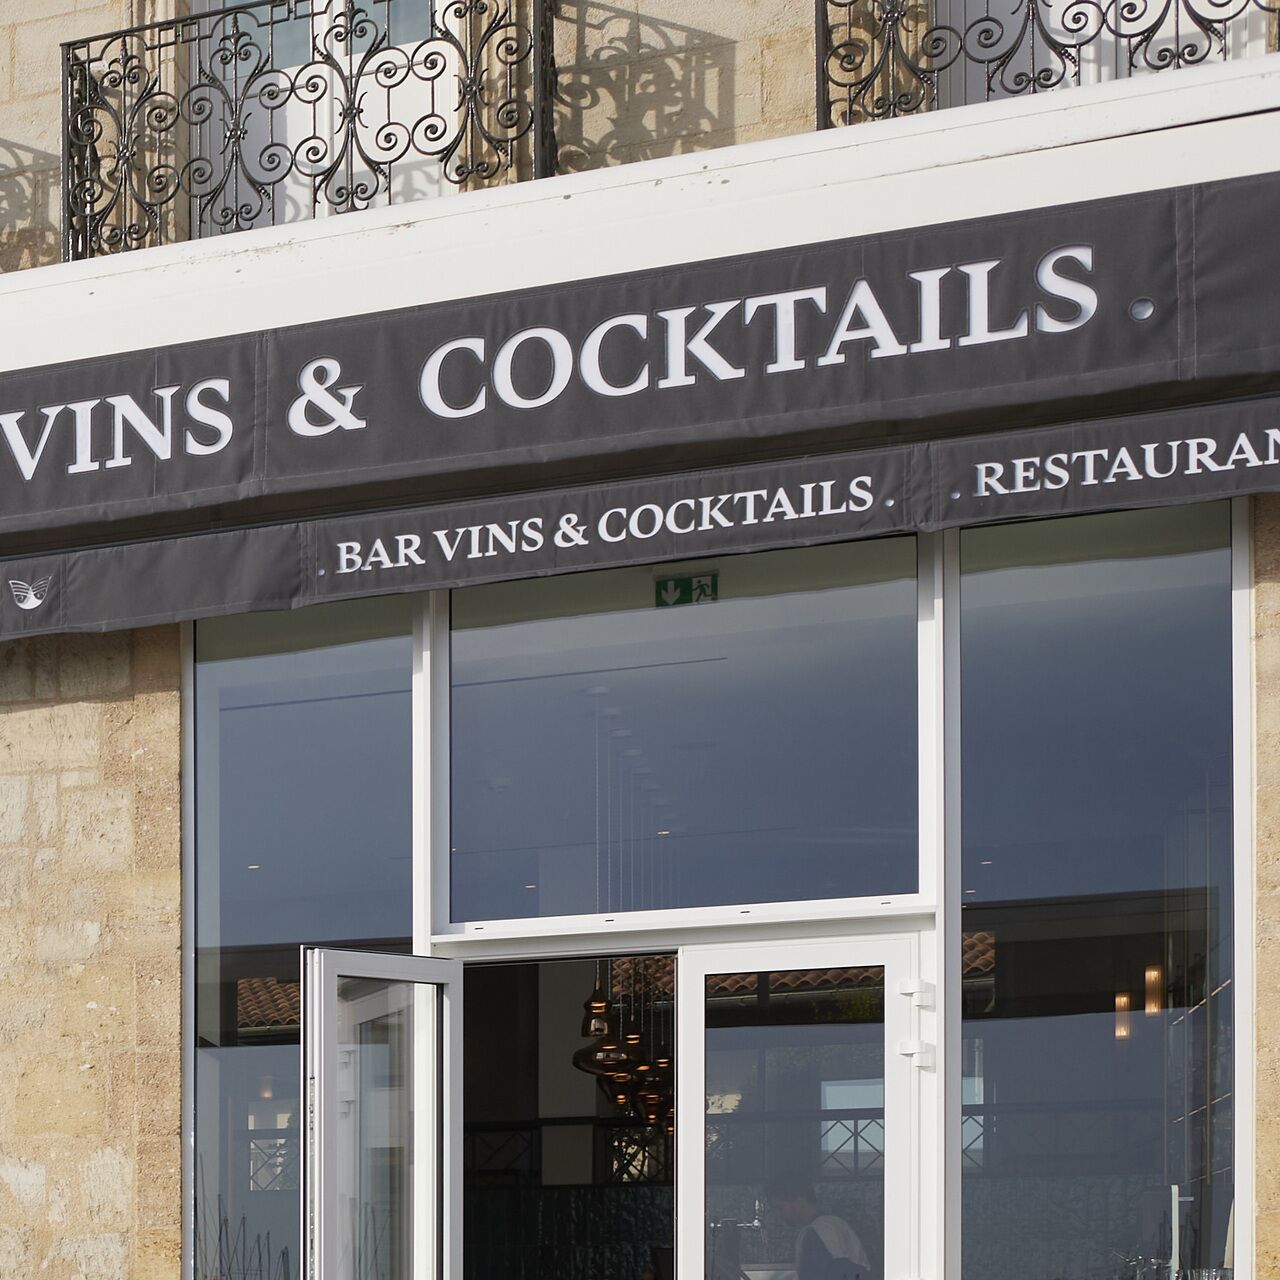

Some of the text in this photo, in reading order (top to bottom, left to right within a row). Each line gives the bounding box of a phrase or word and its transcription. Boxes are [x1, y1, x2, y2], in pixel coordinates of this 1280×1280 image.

[288, 358, 367, 437] &
[419, 245, 1098, 419] COCKTAILS
[336, 475, 874, 574] BAR VINS & COCKTAILS
